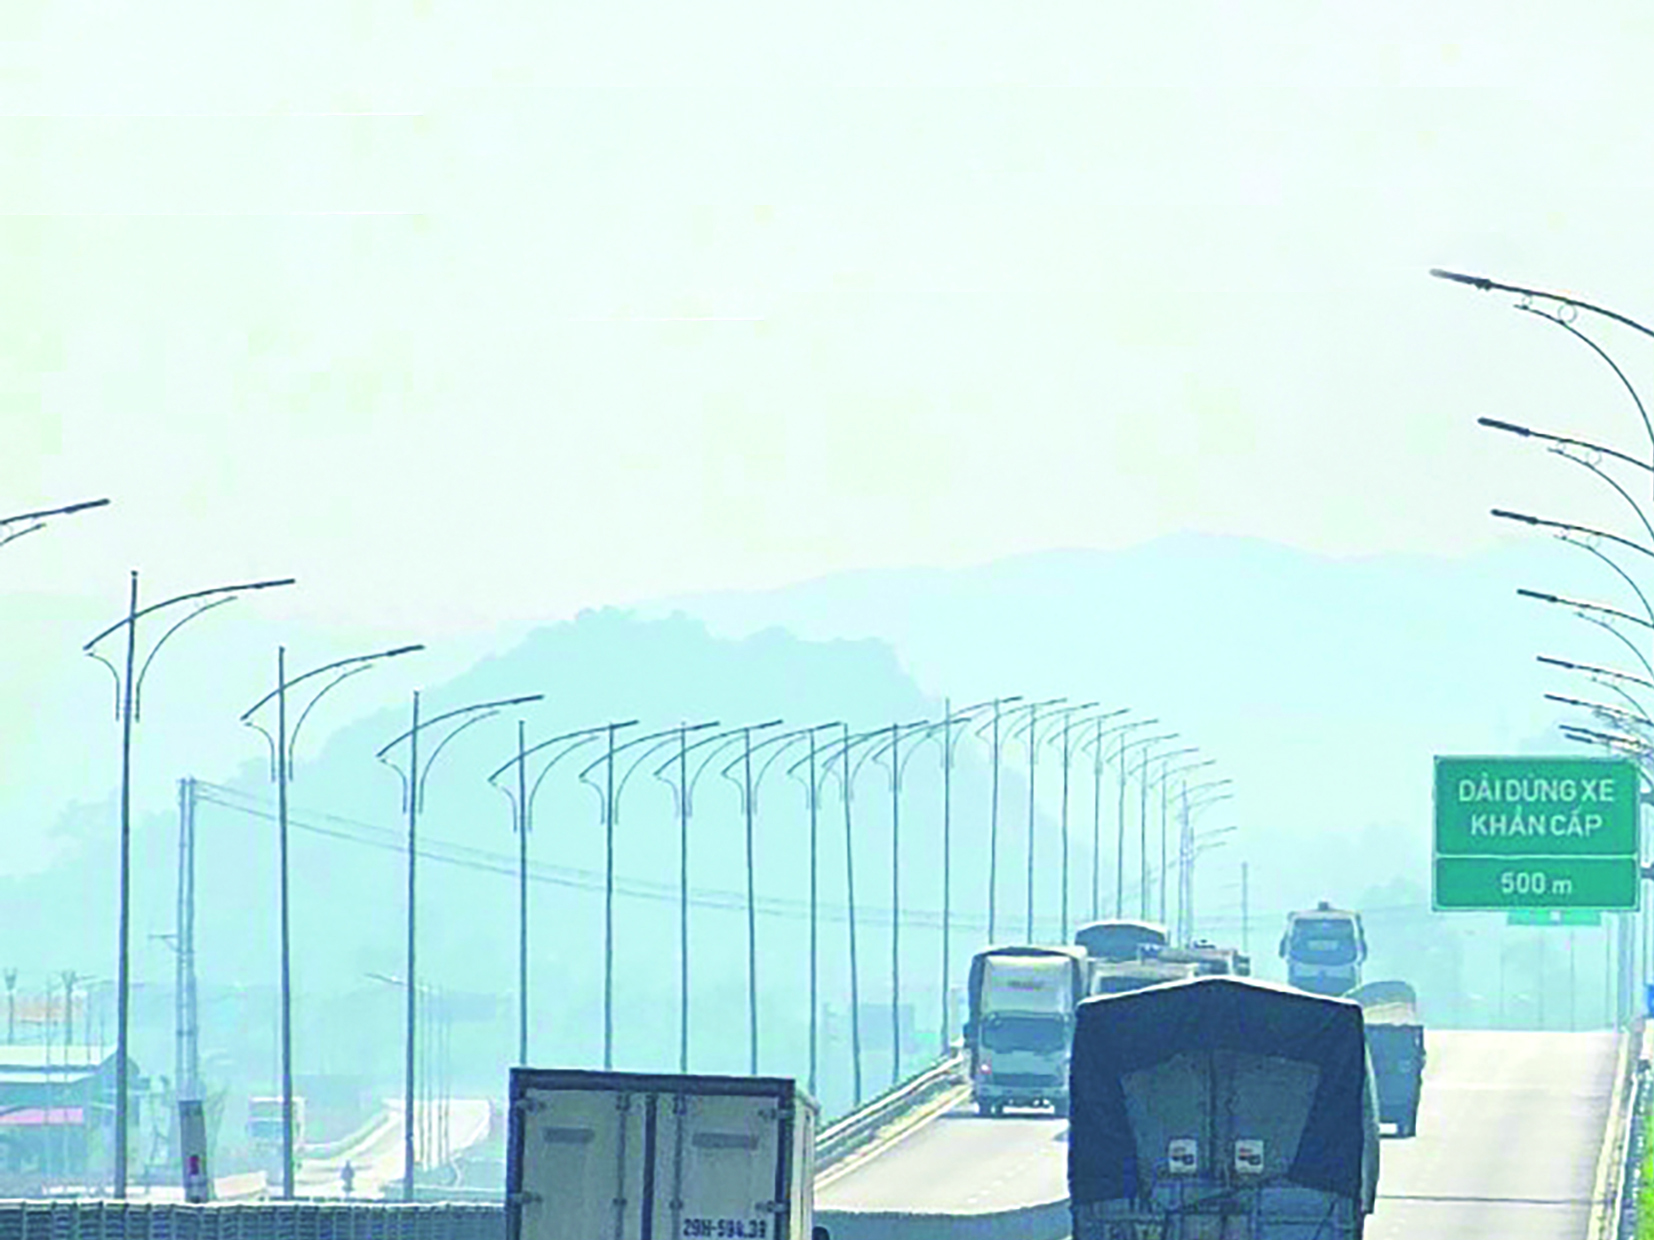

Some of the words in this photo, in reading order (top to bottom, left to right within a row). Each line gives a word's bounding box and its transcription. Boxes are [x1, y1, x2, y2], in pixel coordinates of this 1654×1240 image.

[1581, 779, 1615, 801] XE
[1500, 872, 1545, 894] 500
[1551, 880, 1572, 894] m
